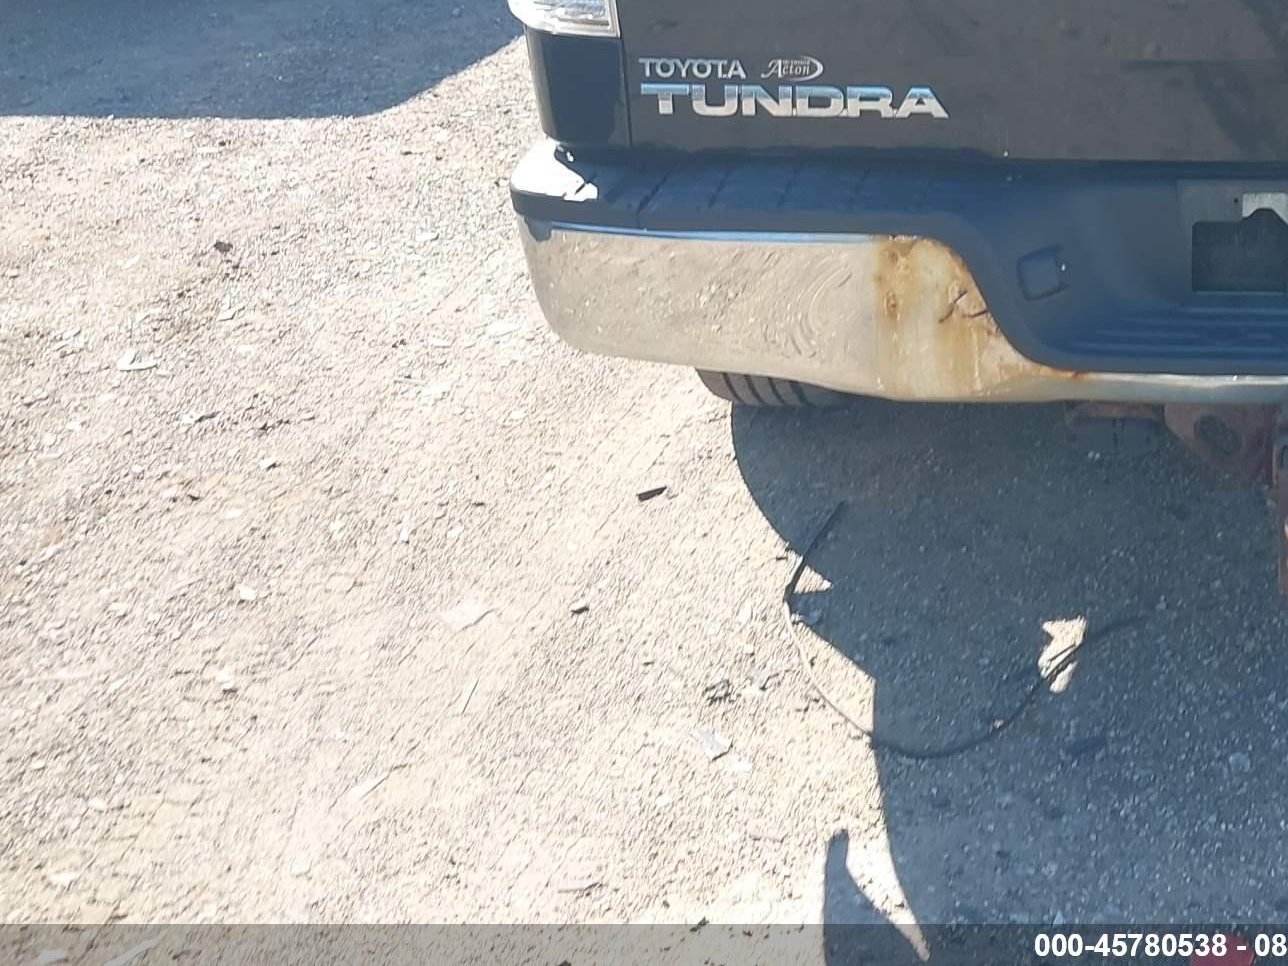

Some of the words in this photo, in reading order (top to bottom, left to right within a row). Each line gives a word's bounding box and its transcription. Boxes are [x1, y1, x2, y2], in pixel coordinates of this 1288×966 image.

[639, 58, 746, 79] TOYOTA
[761, 58, 810, 79] Acton
[640, 83, 949, 119] TUNDRA
